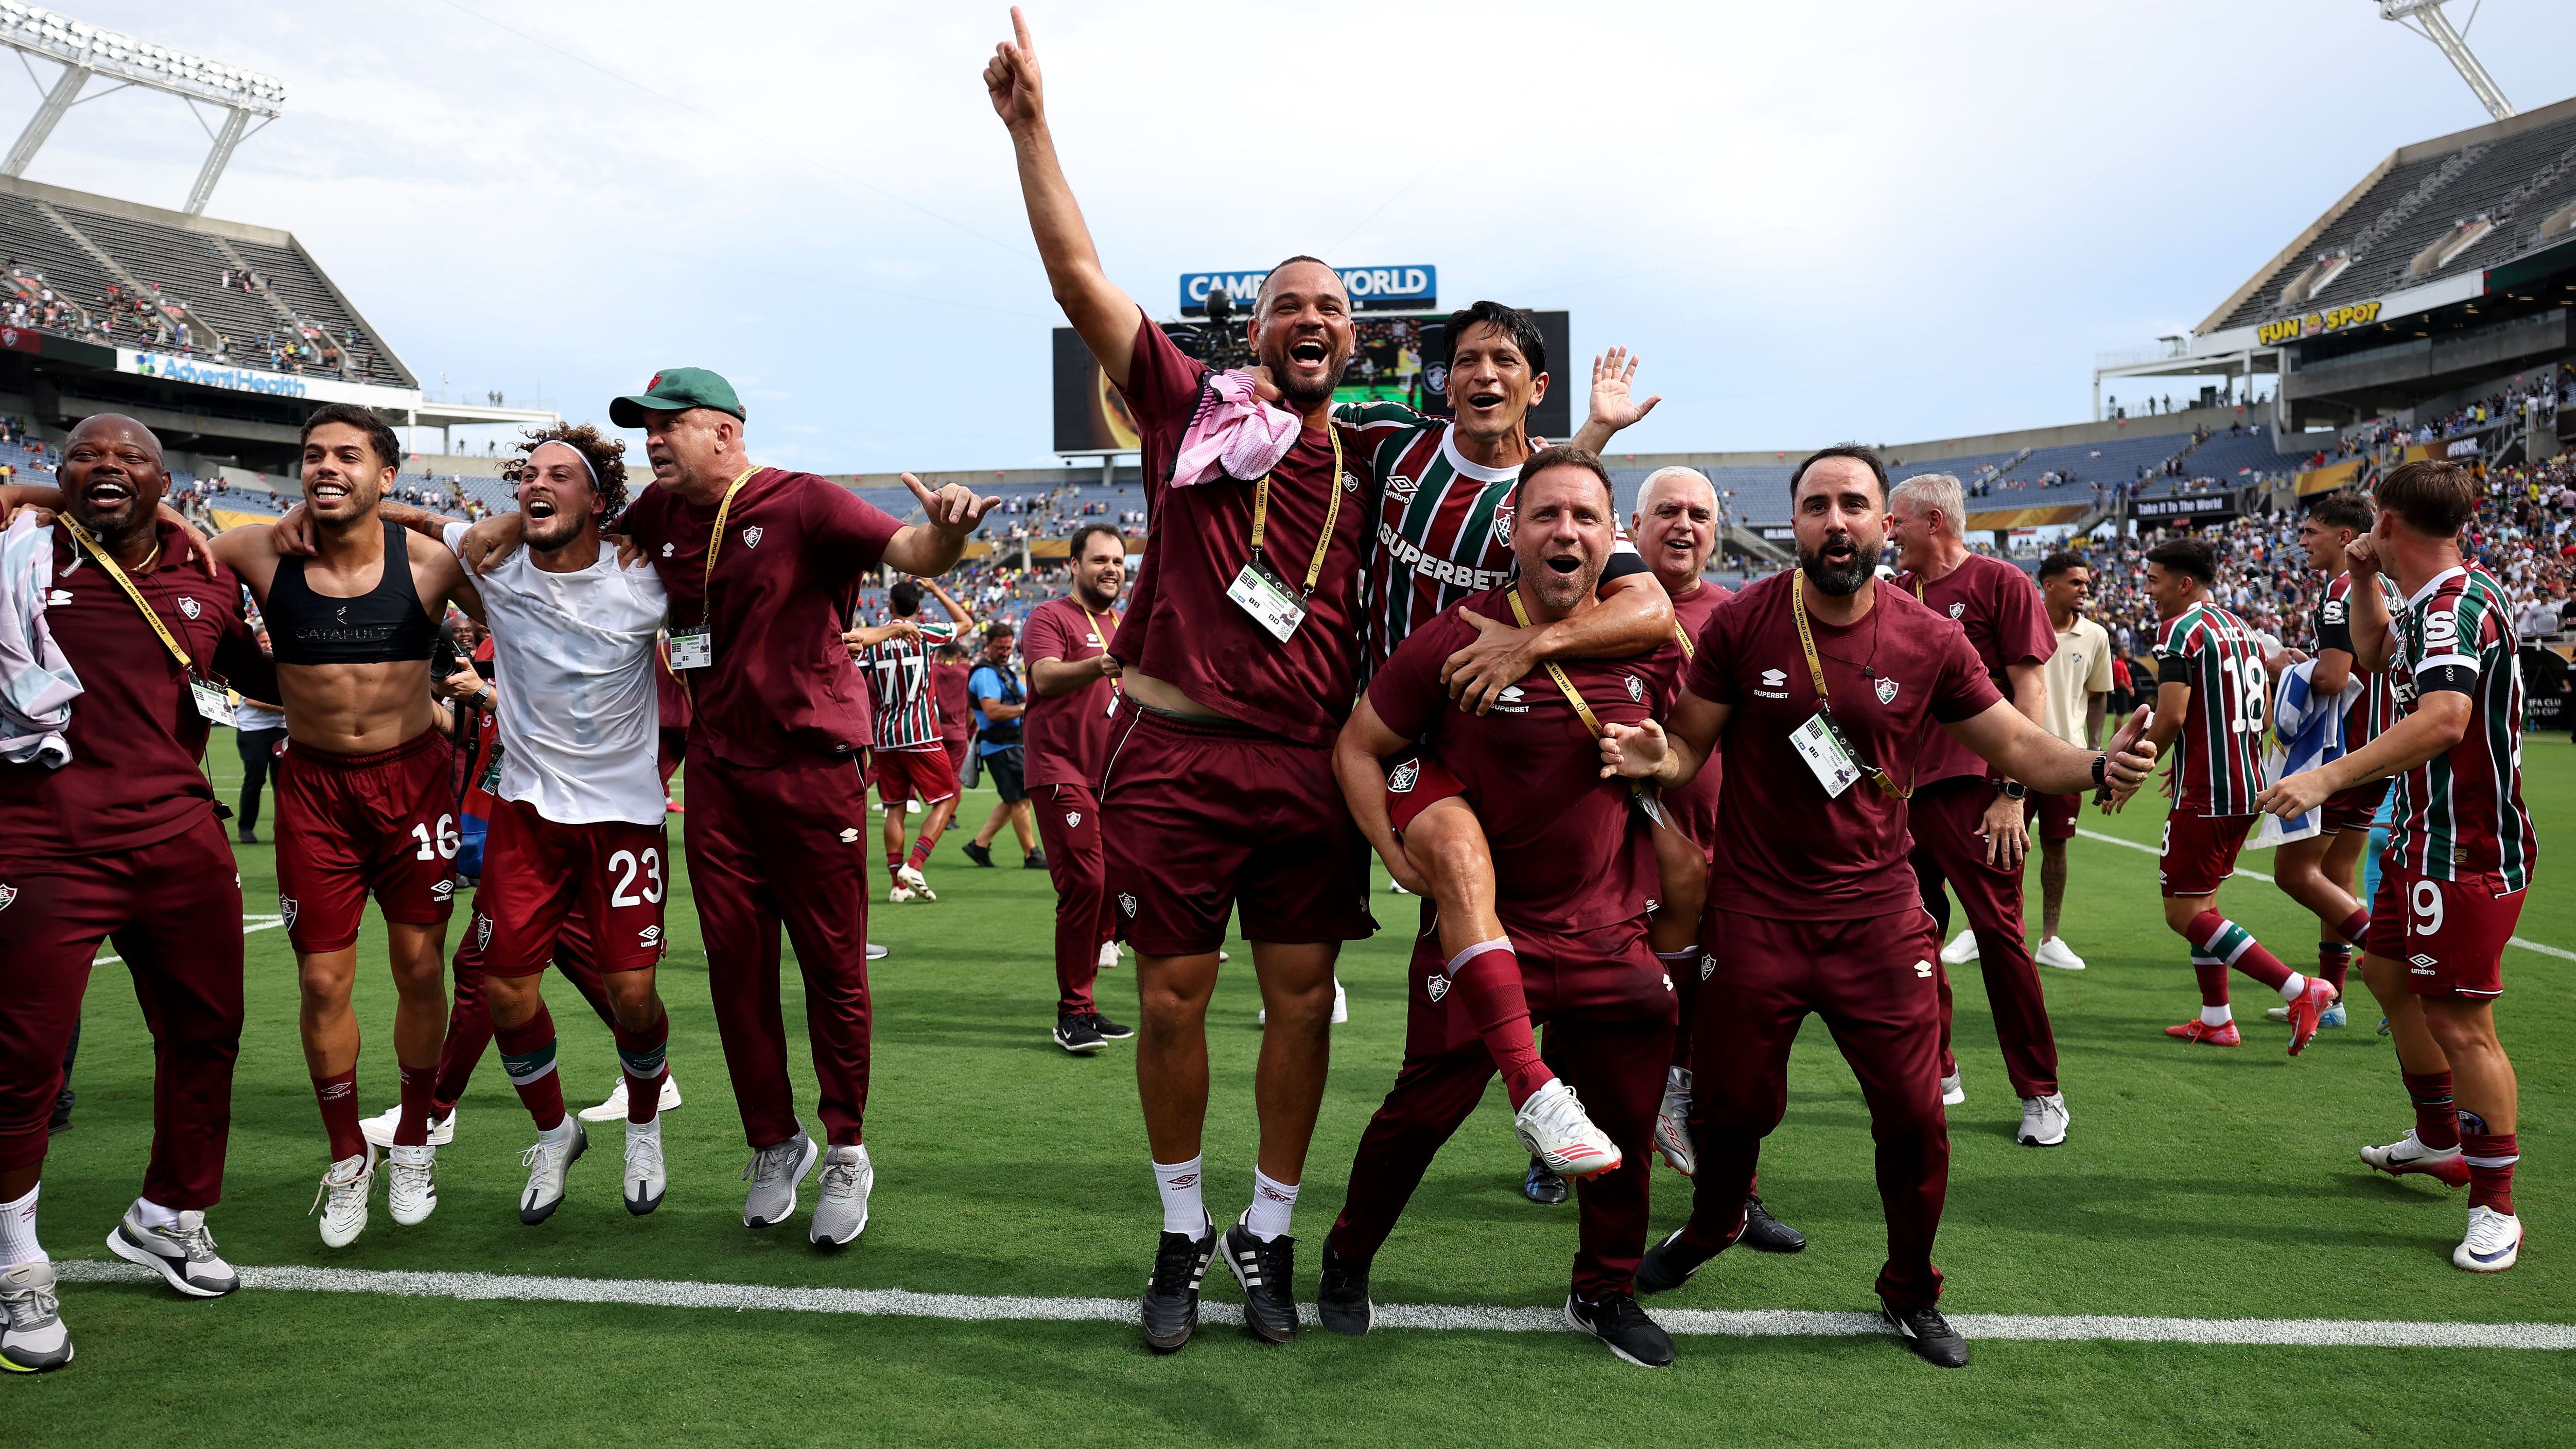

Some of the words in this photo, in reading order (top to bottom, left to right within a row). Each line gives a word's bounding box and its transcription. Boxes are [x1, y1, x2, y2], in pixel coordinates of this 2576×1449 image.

[2258, 318, 2300, 345] FUN
[2326, 302, 2381, 330] SPOT
[163, 359, 306, 396] AdventHealth
[1385, 489, 1410, 504] umbro
[2137, 503, 2159, 515] Take
[2166, 501, 2178, 513] To
[2178, 500, 2196, 512] The
[2196, 497, 2223, 511] World
[1380, 522, 1508, 591] SUPERBET
[128, 585, 136, 595] CUP
[1266, 585, 1276, 593] TEAM
[1274, 591, 1288, 604] DELEGATE
[134, 595, 149, 613] WORLD
[148, 612, 159, 625] CLUB
[1798, 612, 1806, 631] WORLD
[2425, 610, 2458, 642] S
[156, 624, 166, 635] FIFA
[296, 627, 390, 640] CATAPULT
[2211, 626, 2261, 644] LEZCANO
[875, 655, 924, 705] 77
[1551, 667, 1563, 681] CLUB
[1561, 679, 1571, 692] FIFA
[1753, 689, 1789, 699] SUPERBET
[2223, 655, 2266, 733] 18
[1490, 703, 1529, 713] SUPERBET
[1828, 746, 1843, 765] MESQUITA
[1830, 755, 1839, 768] Thiago
[412, 813, 461, 860] 16
[608, 847, 663, 907] 23
[433, 894, 452, 902] umbr
[640, 939, 658, 948] umbr
[2411, 968, 2435, 976] umbro
[323, 1089, 351, 1101] umbro
[1658, 1113, 1687, 1152] F50
[1171, 1180, 1198, 1191] umbro
